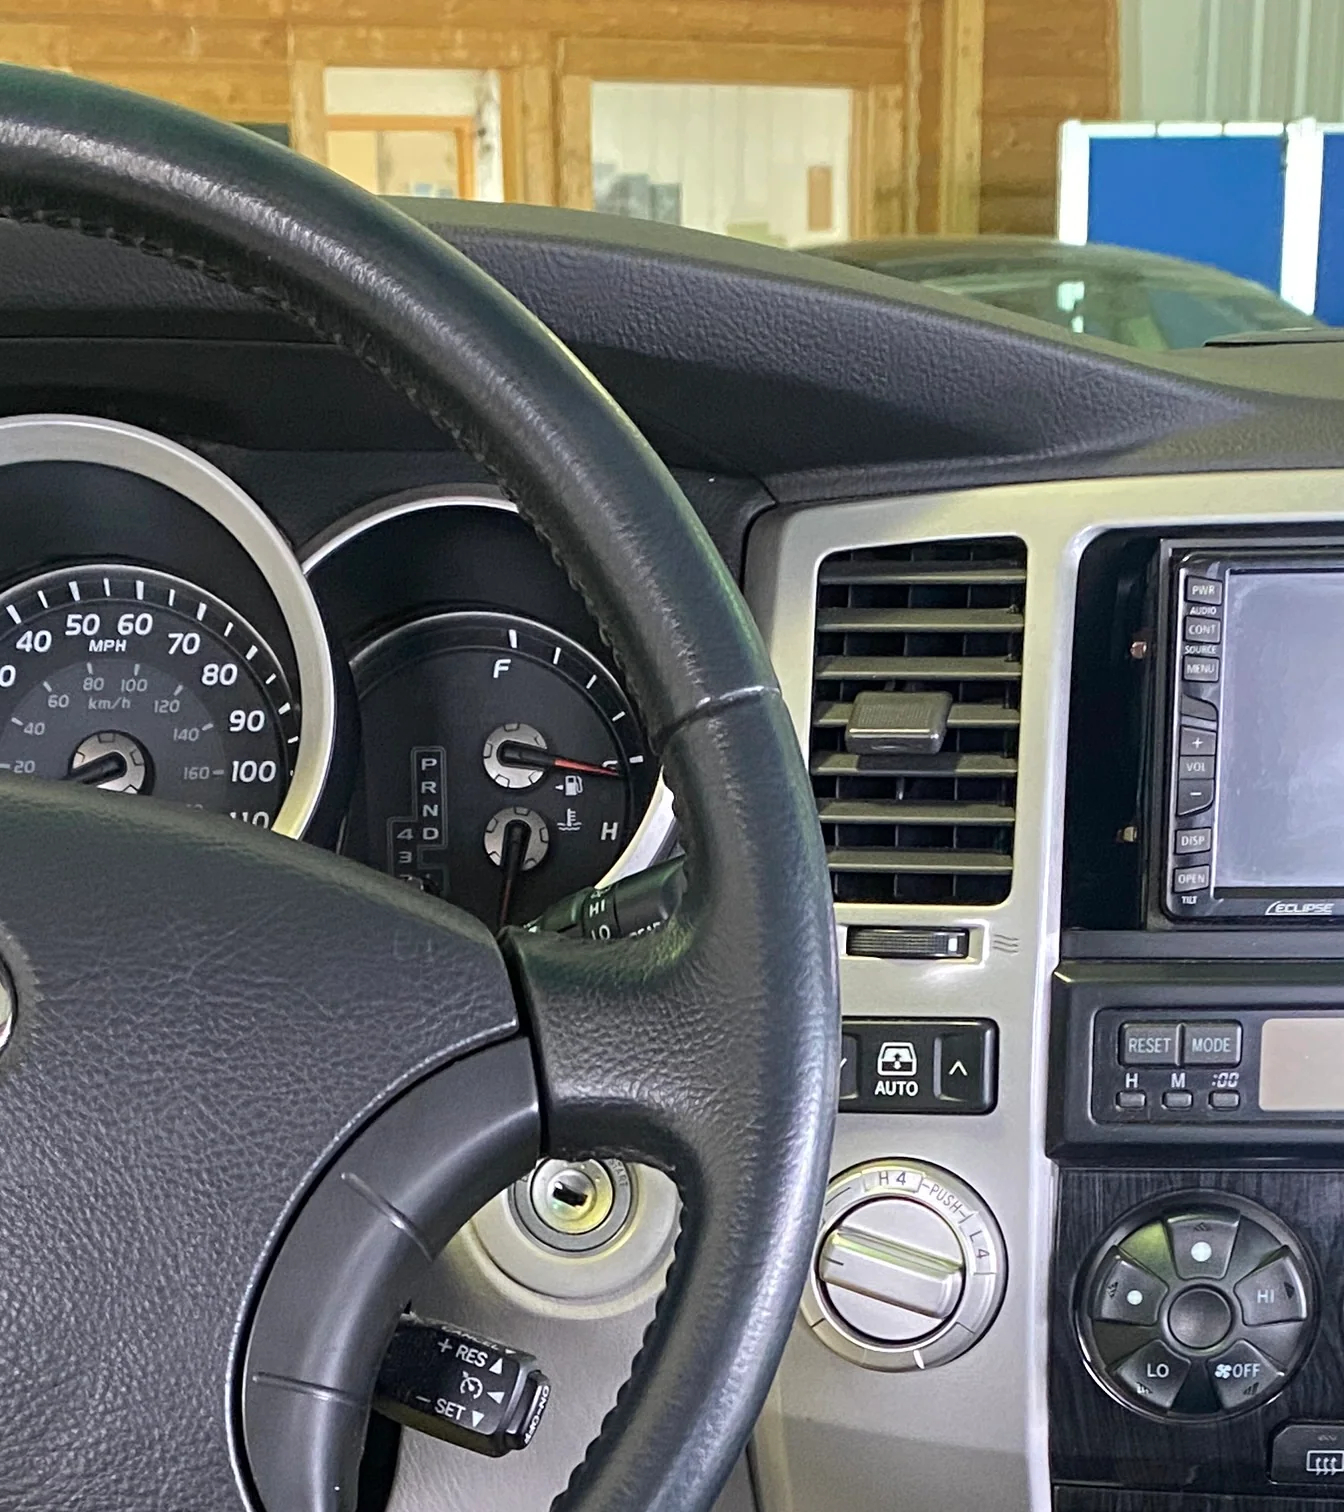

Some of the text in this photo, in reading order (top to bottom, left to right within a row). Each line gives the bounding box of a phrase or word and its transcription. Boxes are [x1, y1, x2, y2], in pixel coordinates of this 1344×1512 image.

[1192, 585, 1215, 595] PWR
[1190, 607, 1217, 615] AUDIO
[65, 614, 101, 636] 50
[117, 613, 153, 636] 60
[1188, 625, 1216, 635] CONT
[16, 630, 52, 652] 40
[89, 639, 127, 652] MPH
[167, 632, 201, 655] 70
[1184, 645, 1217, 654] SOURCE
[201, 663, 238, 686] 80
[493, 659, 511, 678] F
[1186, 664, 1214, 674] MENU
[83, 677, 104, 691] 80
[121, 679, 148, 692] 100
[47, 695, 69, 708] 60
[88, 697, 131, 710] km/h
[154, 700, 180, 713] 120
[229, 710, 265, 732] 90
[23, 722, 45, 735] 40
[173, 728, 200, 741] 140
[14, 760, 36, 774] 20
[421, 758, 437, 771] P
[1186, 762, 1206, 772] VOL
[183, 767, 209, 780] 160
[231, 760, 276, 783] 100
[421, 781, 437, 794] R
[423, 804, 438, 817] N
[397, 827, 439, 840] 4 D
[601, 822, 618, 840] H
[1181, 835, 1205, 846] DISP
[400, 851, 412, 863] 3
[1178, 874, 1205, 884] OPEN
[1270, 902, 1335, 915] ECLIPSE
[1128, 1037, 1231, 1054] RESET MODE
[1126, 1073, 1138, 1088] H
[1171, 1073, 1185, 1088] M
[874, 1080, 919, 1097] AUTO
[1257, 1289, 1275, 1303] HI
[456, 1344, 488, 1367] RES
[1147, 1363, 1169, 1378] LO
[1232, 1363, 1261, 1378] OFF
[434, 1398, 467, 1420] SET
